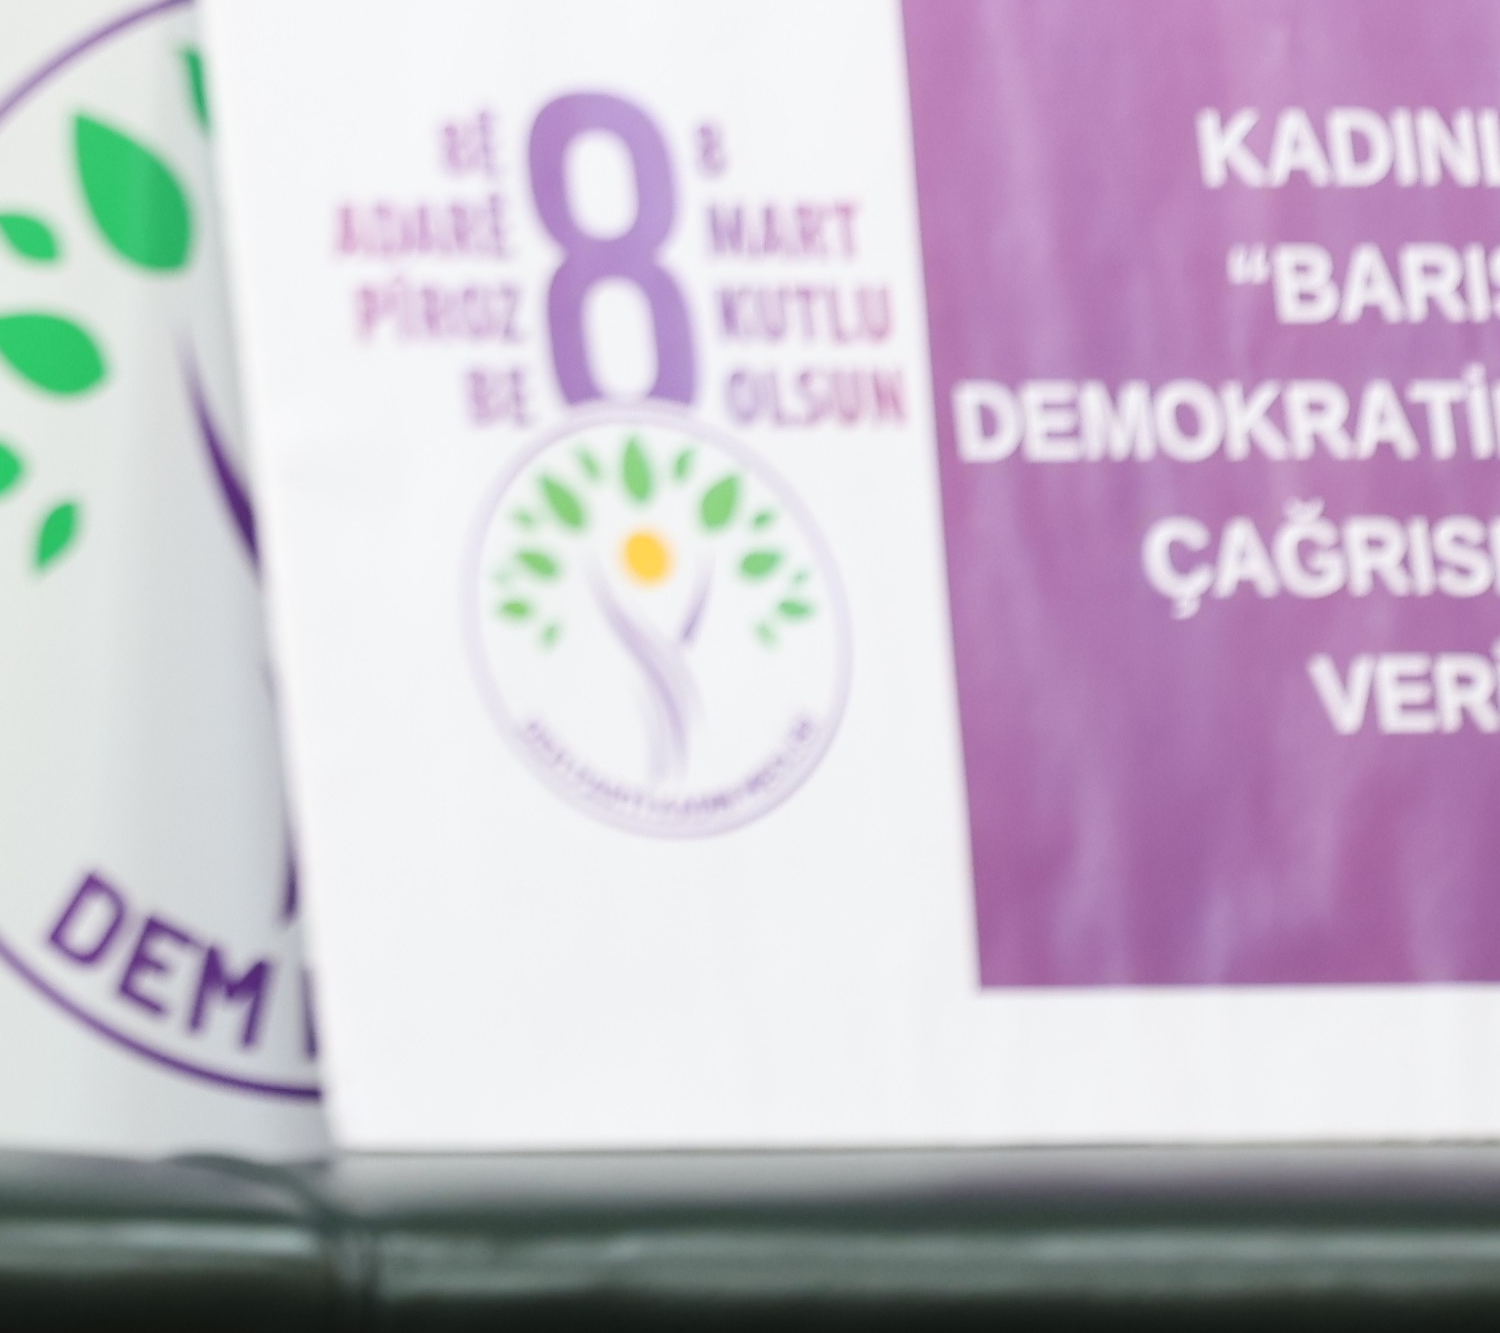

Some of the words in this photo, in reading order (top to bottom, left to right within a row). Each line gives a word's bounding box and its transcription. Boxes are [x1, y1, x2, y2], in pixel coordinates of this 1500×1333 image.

[529, 93, 696, 406] 8
[709, 203, 857, 257] MART
[718, 285, 893, 343] KUTLU
[727, 367, 906, 427] OLSUN
[48, 871, 272, 1049] DEM
